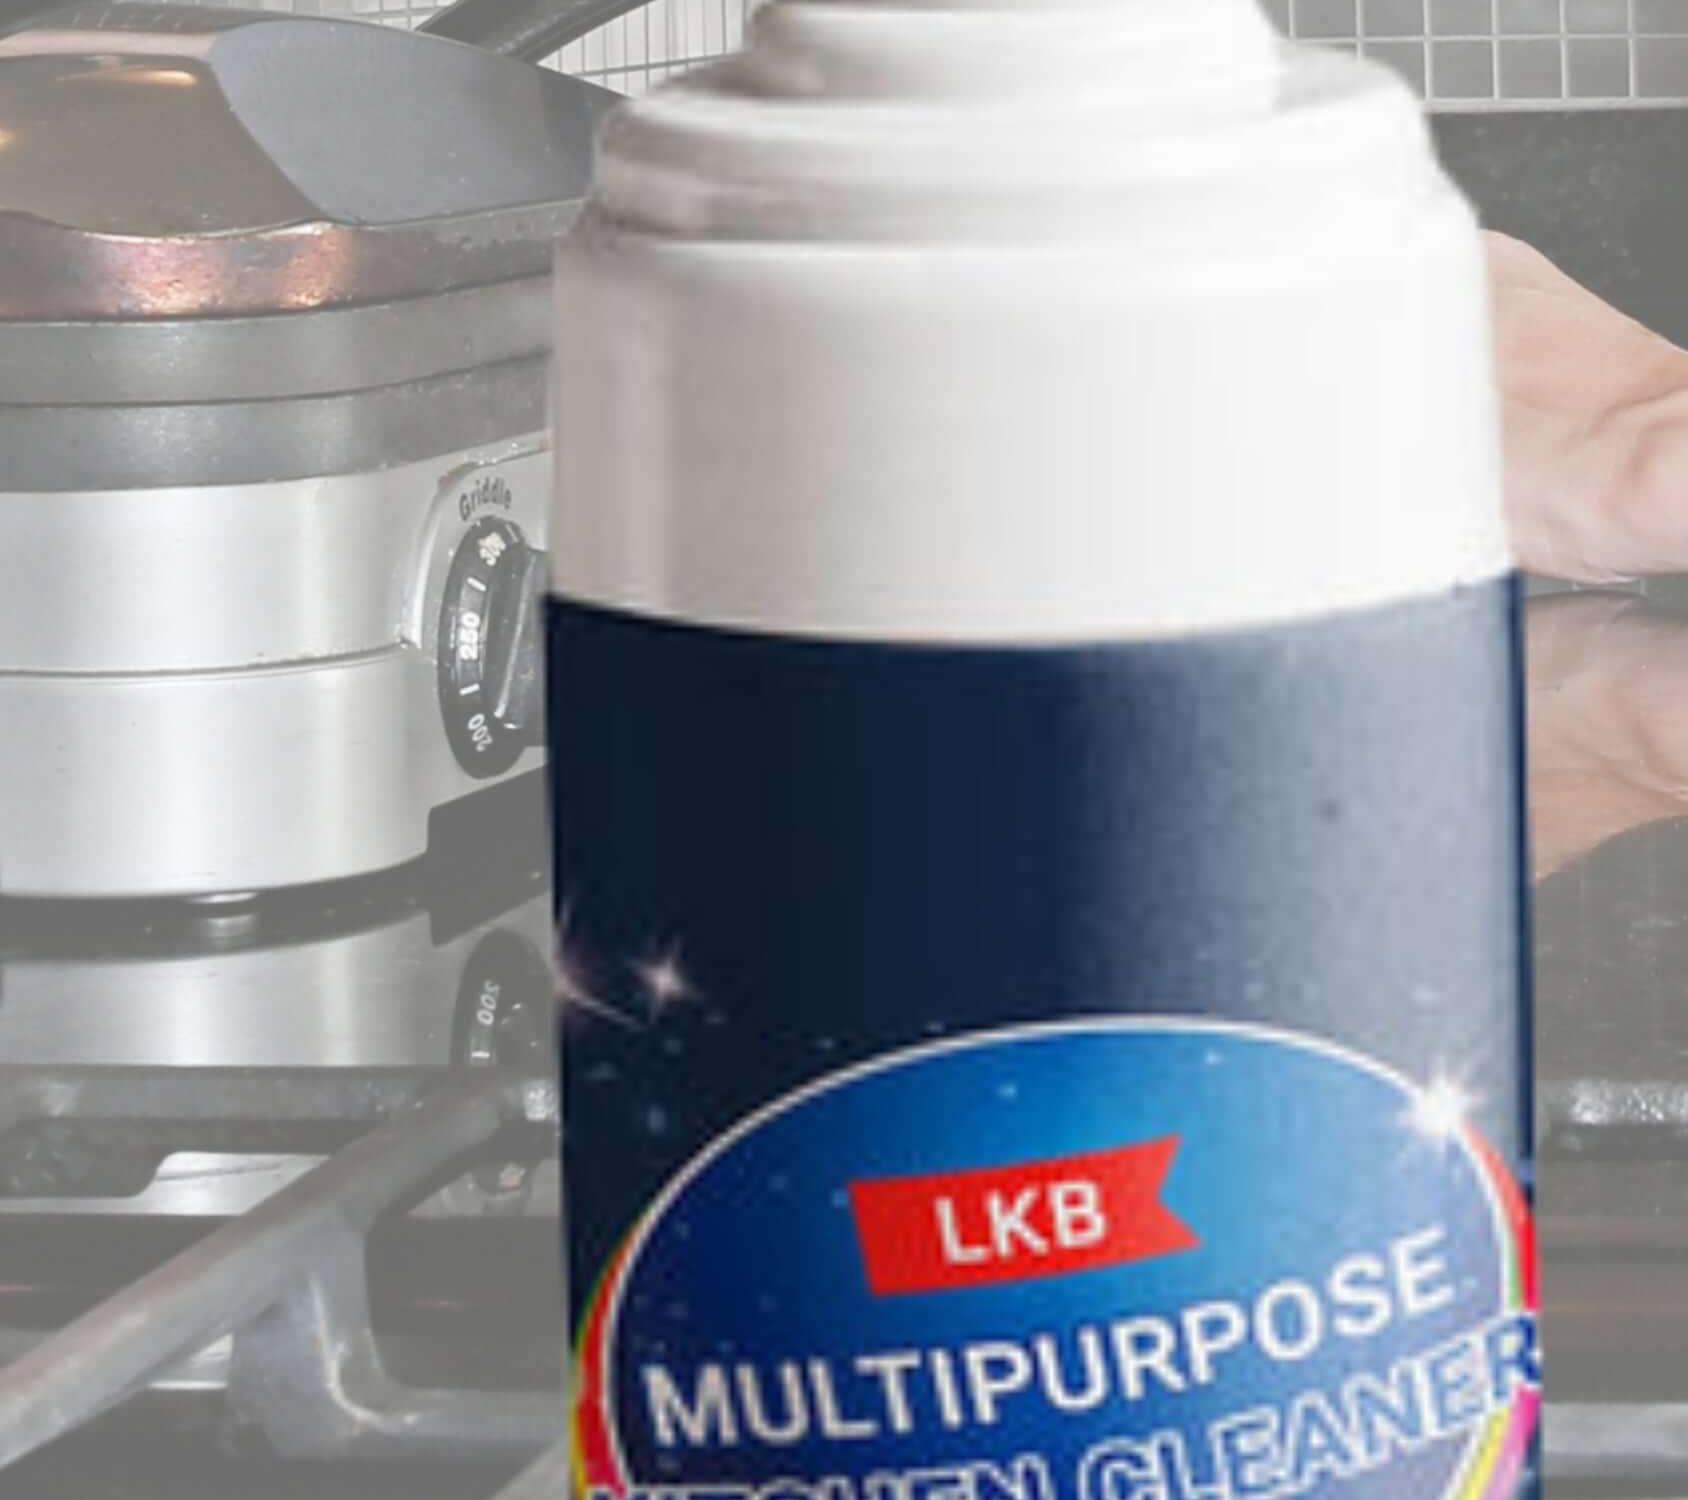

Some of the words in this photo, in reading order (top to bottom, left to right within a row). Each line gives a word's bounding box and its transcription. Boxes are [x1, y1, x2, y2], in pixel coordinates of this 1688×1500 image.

[459, 477, 512, 521] Griddle
[458, 611, 481, 660] 250
[467, 713, 493, 752] 200
[933, 1178, 1108, 1266] LKB
[642, 1227, 1454, 1449] MULTIPURPOSE
